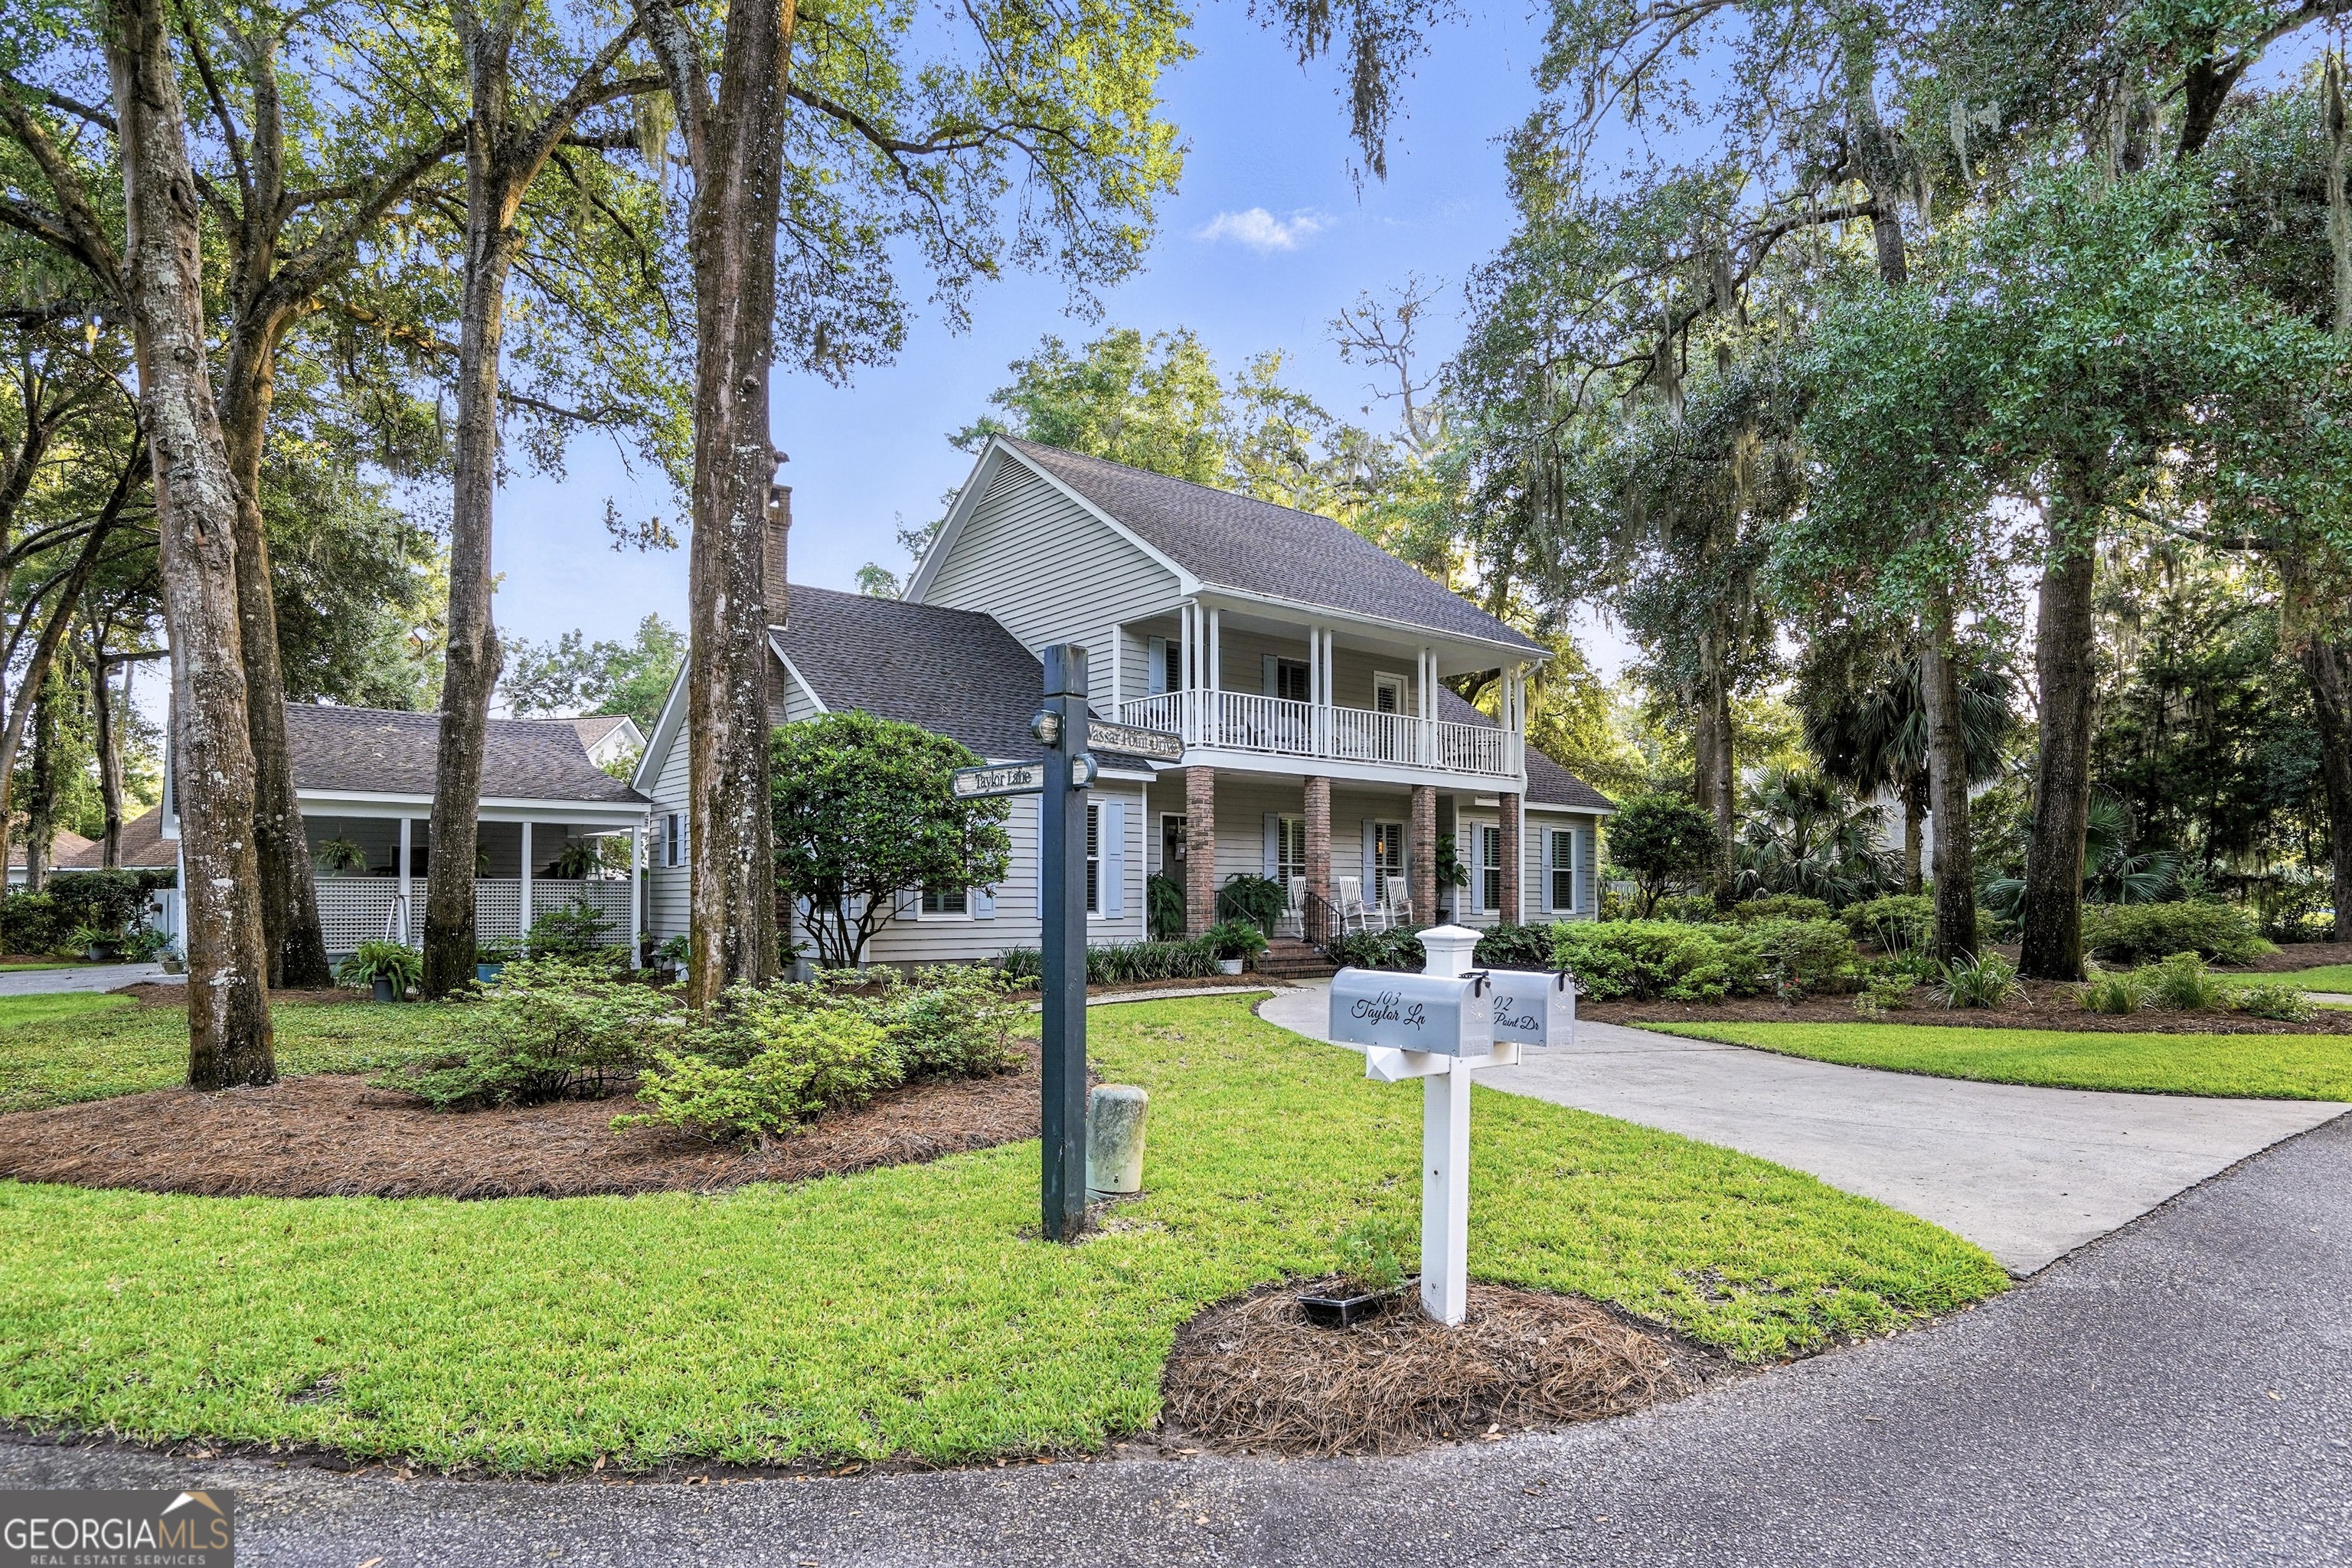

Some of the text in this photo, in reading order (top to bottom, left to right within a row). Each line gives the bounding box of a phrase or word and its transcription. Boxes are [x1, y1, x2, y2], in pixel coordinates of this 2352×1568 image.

[1122, 728, 1148, 749] Point
[1150, 734, 1178, 753] Drive
[975, 768, 1032, 792] Taylor Lane
[1376, 991, 1402, 1006] 103
[1351, 999, 1426, 1031] Taylor Ln
[1493, 1011, 1540, 1031] Point Dr
